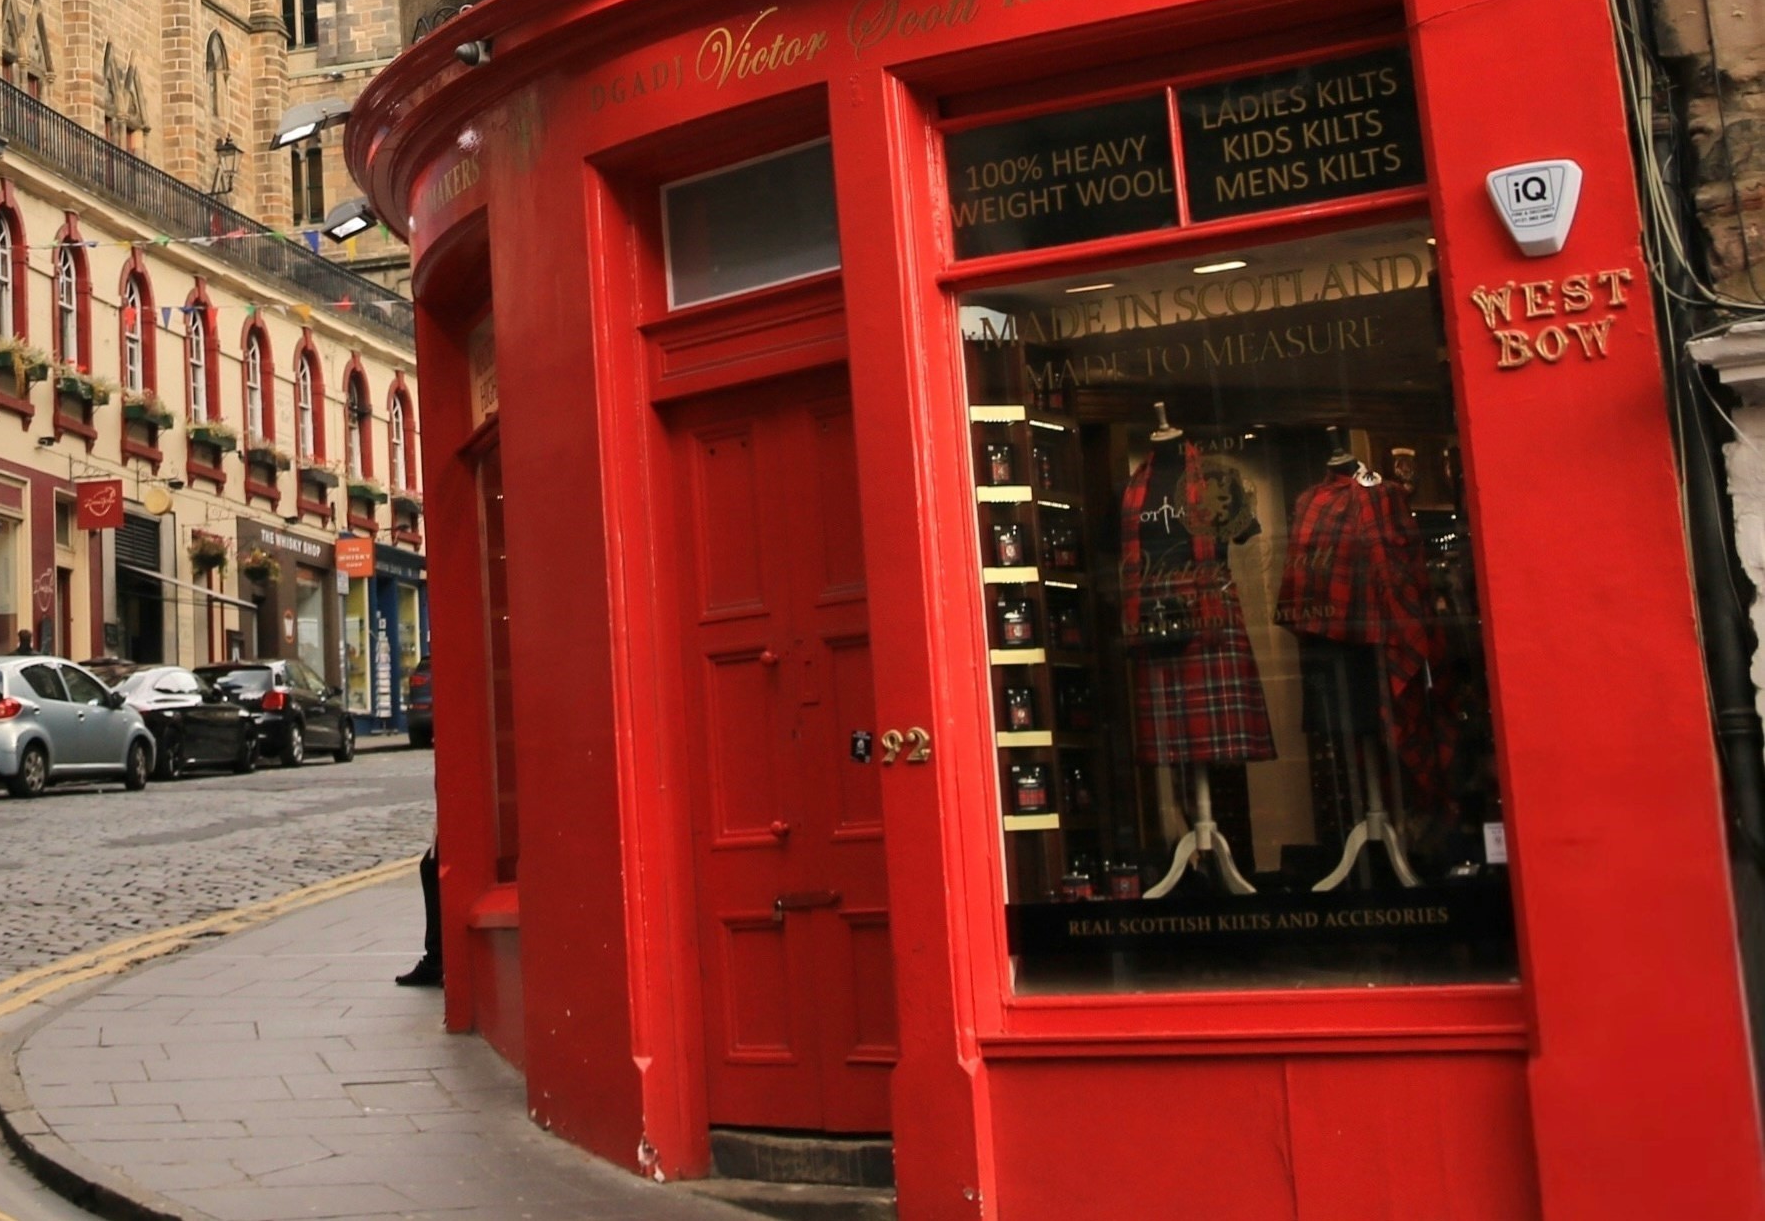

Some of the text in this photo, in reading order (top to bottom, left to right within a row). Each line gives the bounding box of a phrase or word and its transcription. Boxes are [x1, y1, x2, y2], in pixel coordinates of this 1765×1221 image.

[695, 6, 828, 90] Victor
[1200, 66, 1399, 132] LADIES KILTS
[964, 134, 1148, 193] 100% HEAVY
[1221, 109, 1385, 164] KIDS KILTS
[950, 167, 1173, 229] WEIGHT WOOL
[1215, 143, 1402, 203] MENS KILTS
[1513, 176, 1547, 203] iQ
[978, 251, 1424, 353] MADE IN SCOTLAND
[1469, 268, 1635, 330] WEST
[1141, 341, 1193, 375] TO
[1201, 314, 1387, 369] MEASURE
[1493, 314, 1618, 370] BOW
[261, 529, 321, 559] THE WHISKY SHOP
[338, 553, 371, 562] WHISKY
[881, 726, 932, 763] 92
[1068, 906, 1450, 937] REAL SCOTTISH KILTS AND ACCESORIES
